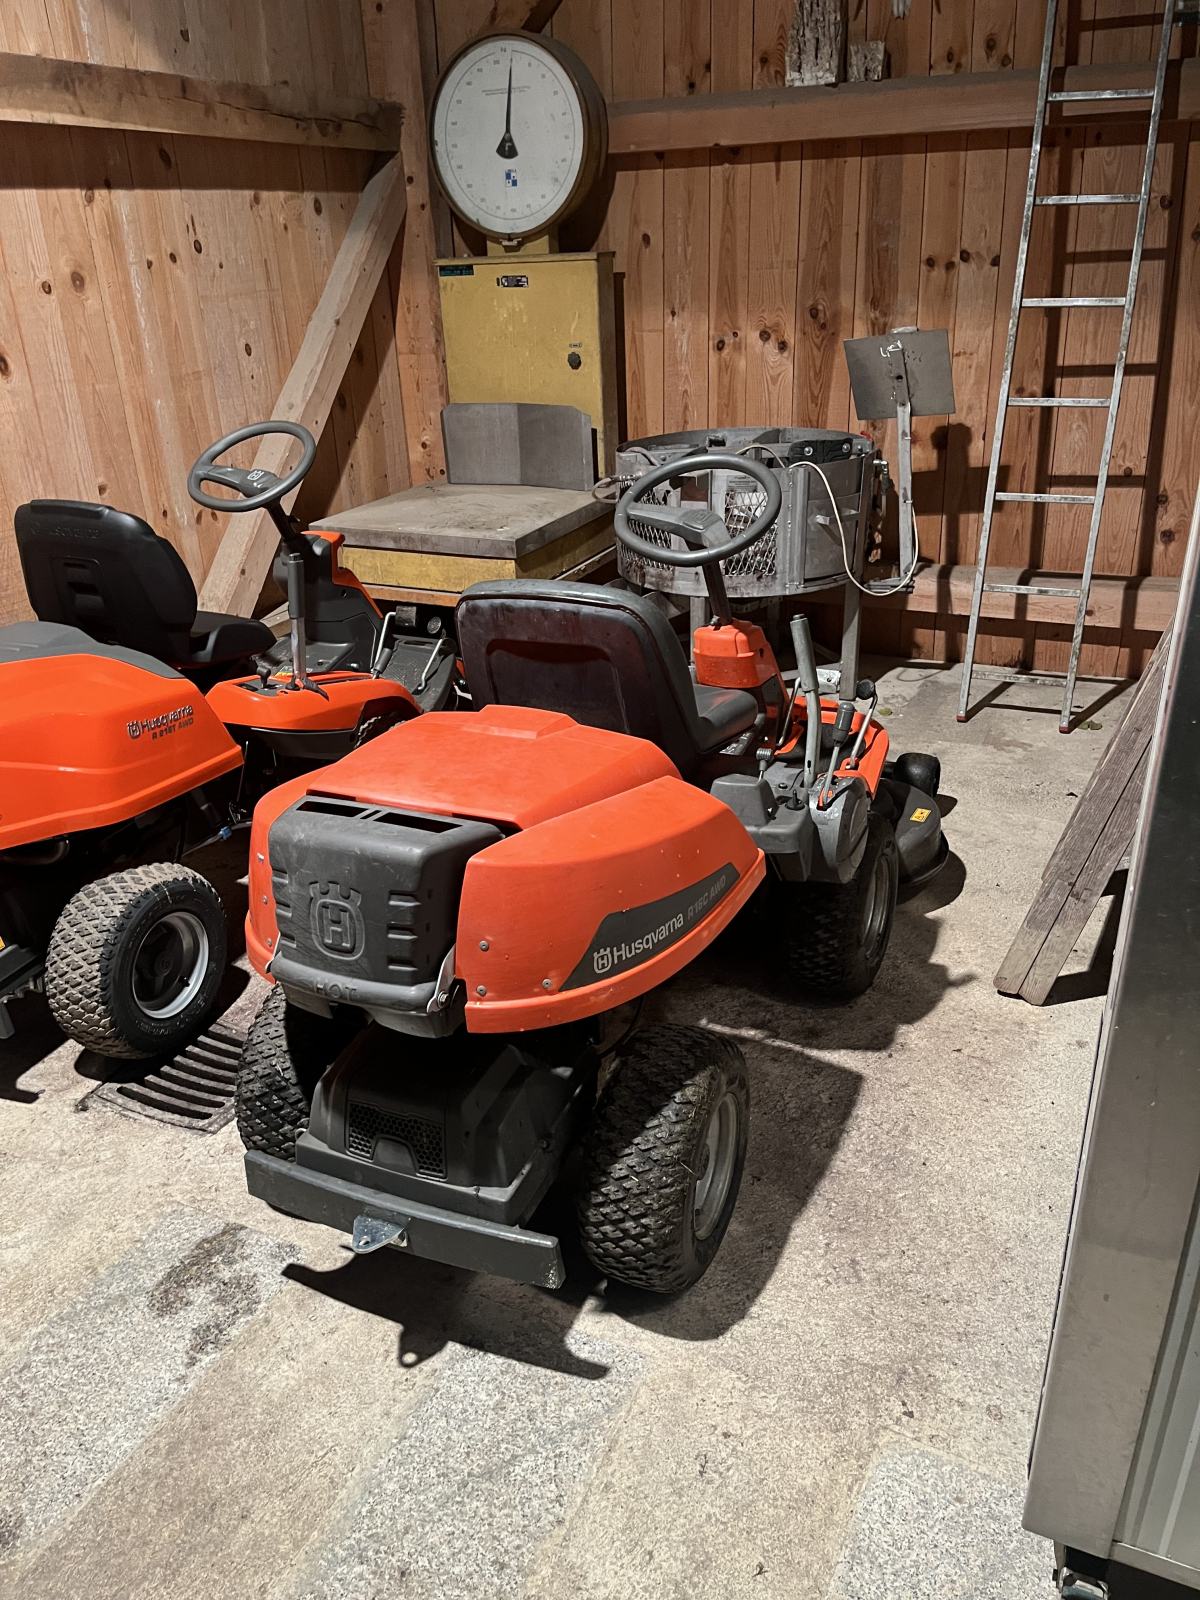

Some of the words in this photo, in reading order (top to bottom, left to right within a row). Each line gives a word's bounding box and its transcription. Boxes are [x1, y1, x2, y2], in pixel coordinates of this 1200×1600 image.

[141, 705, 194, 735] Husqvarna
[613, 913, 684, 965] Husqvarna
[709, 875, 726, 900] AWD
[316, 983, 358, 1001] HOT
